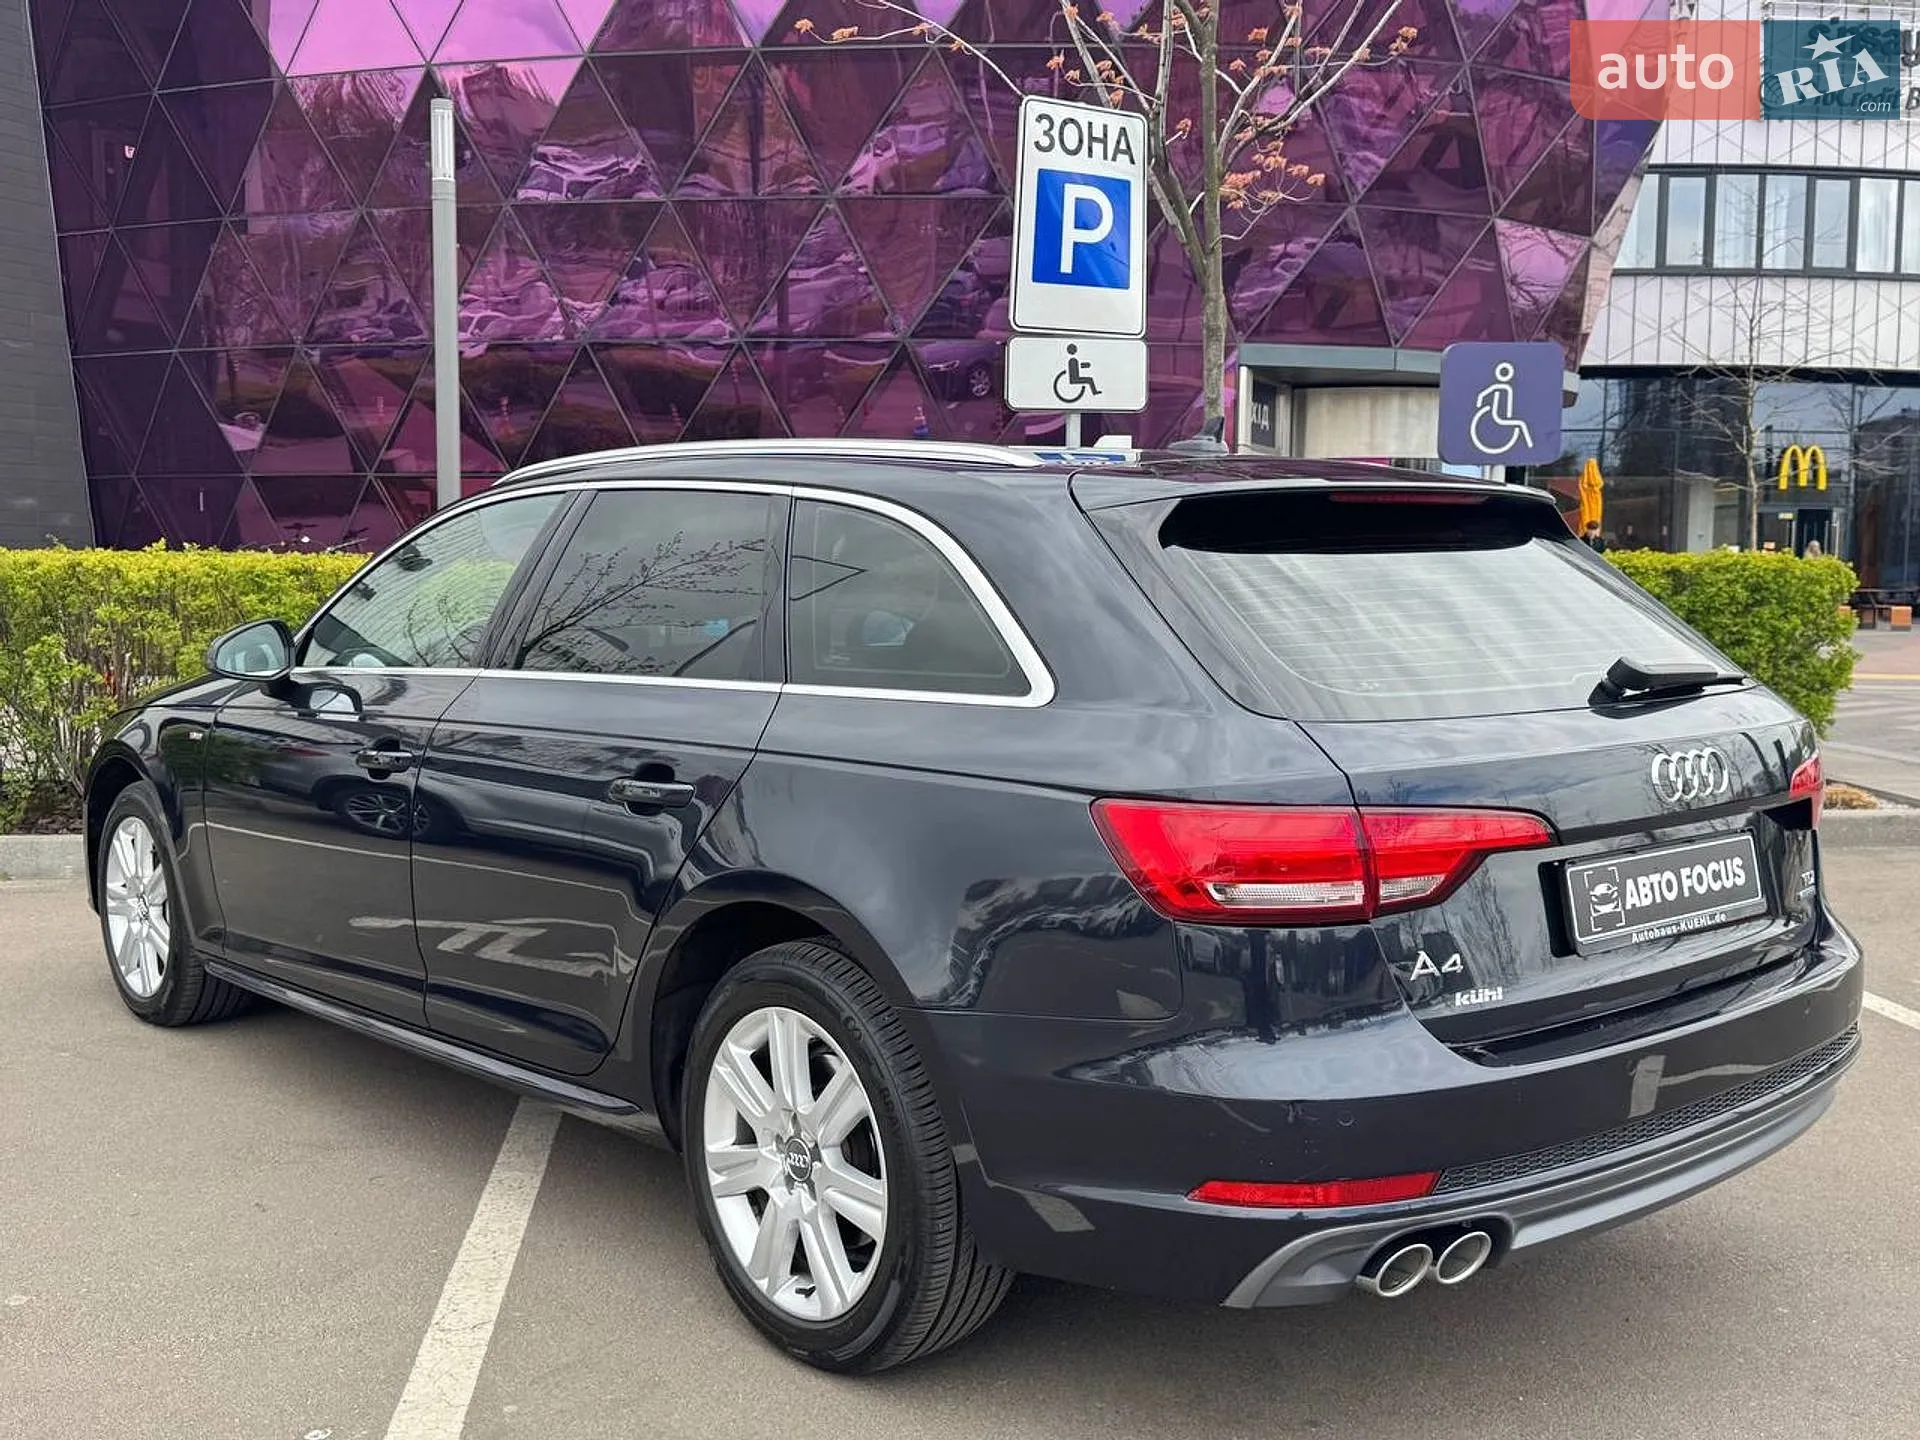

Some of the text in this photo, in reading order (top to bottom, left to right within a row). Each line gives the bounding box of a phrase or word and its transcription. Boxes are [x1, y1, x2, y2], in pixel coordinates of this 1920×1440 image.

[1034, 113, 1135, 165] ЗОНА
[1060, 183, 1114, 274] P
[1680, 856, 1746, 898] FOCUS
[1631, 912, 1728, 944] Autohaus-KUEHL.de
[1409, 950, 1464, 981] A4
